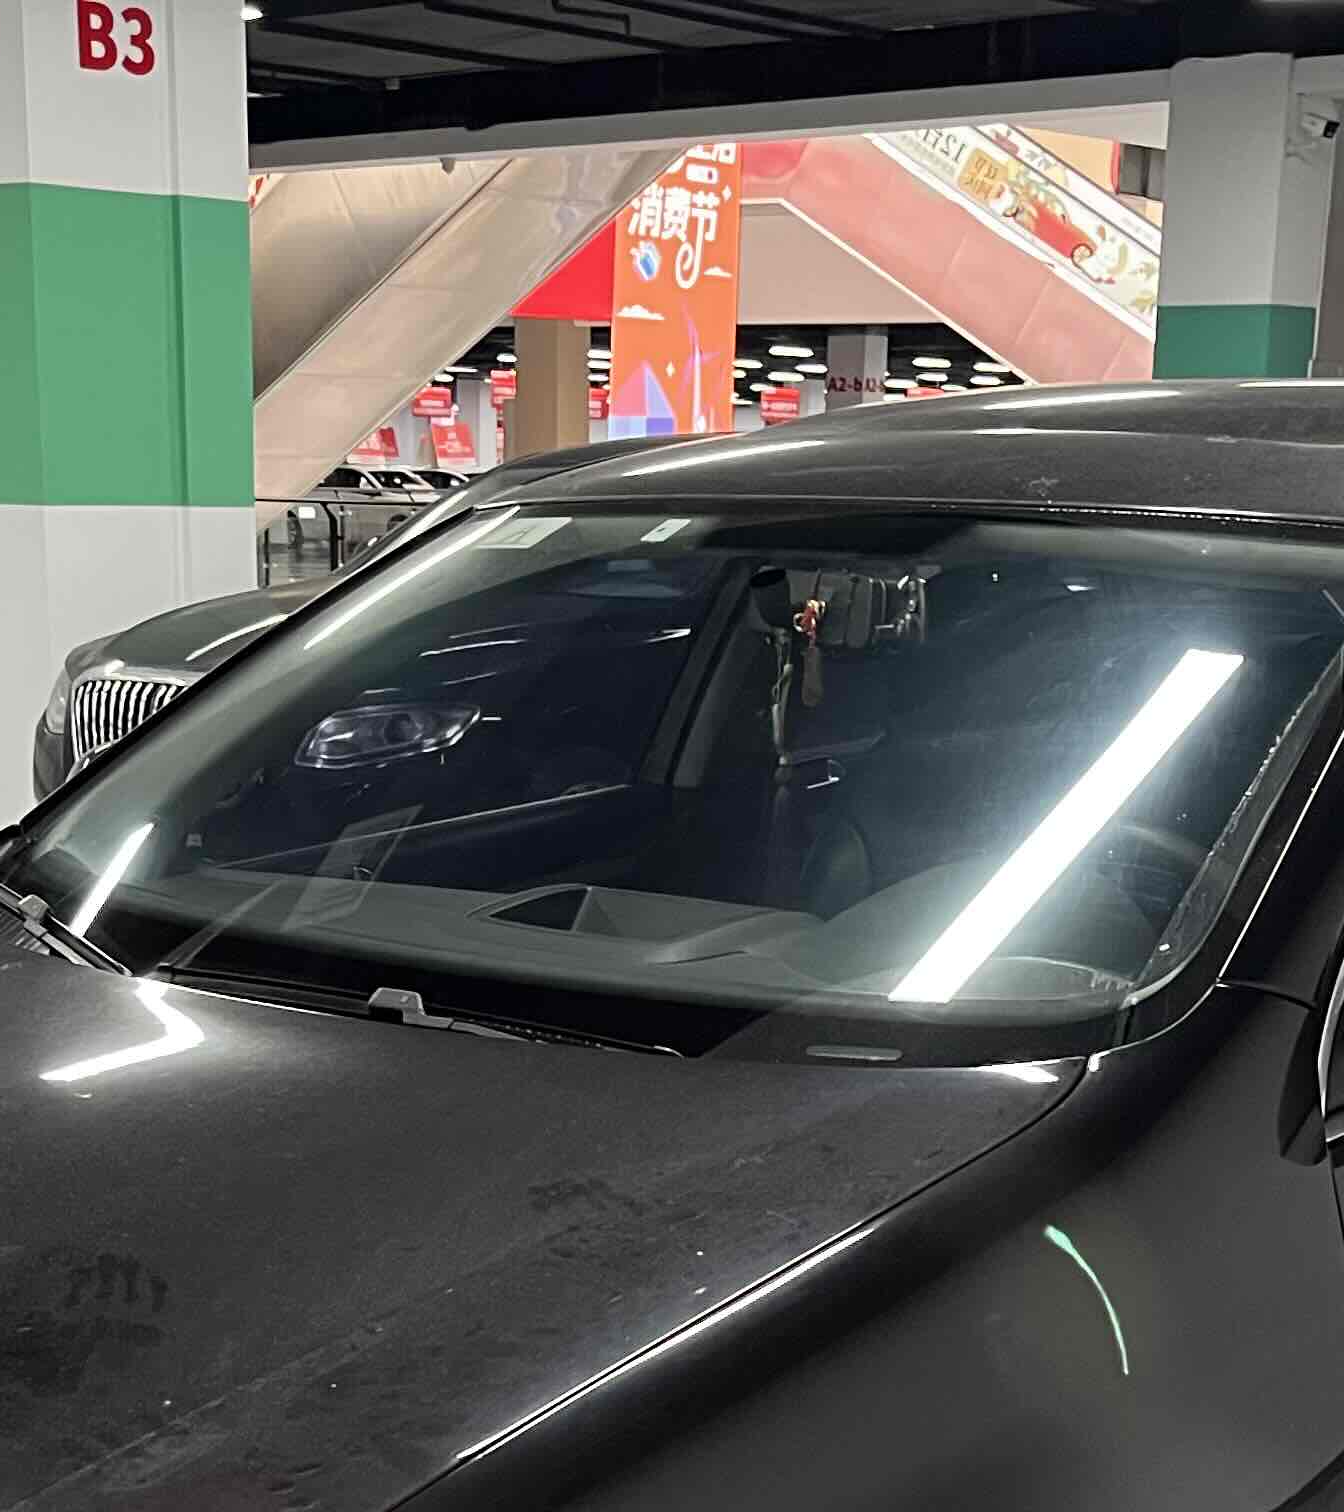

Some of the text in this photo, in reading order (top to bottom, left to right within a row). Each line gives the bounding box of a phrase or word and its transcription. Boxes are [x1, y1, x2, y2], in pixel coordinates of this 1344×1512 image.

[76, 0, 156, 76] B3
[623, 183, 721, 288] 消费节
